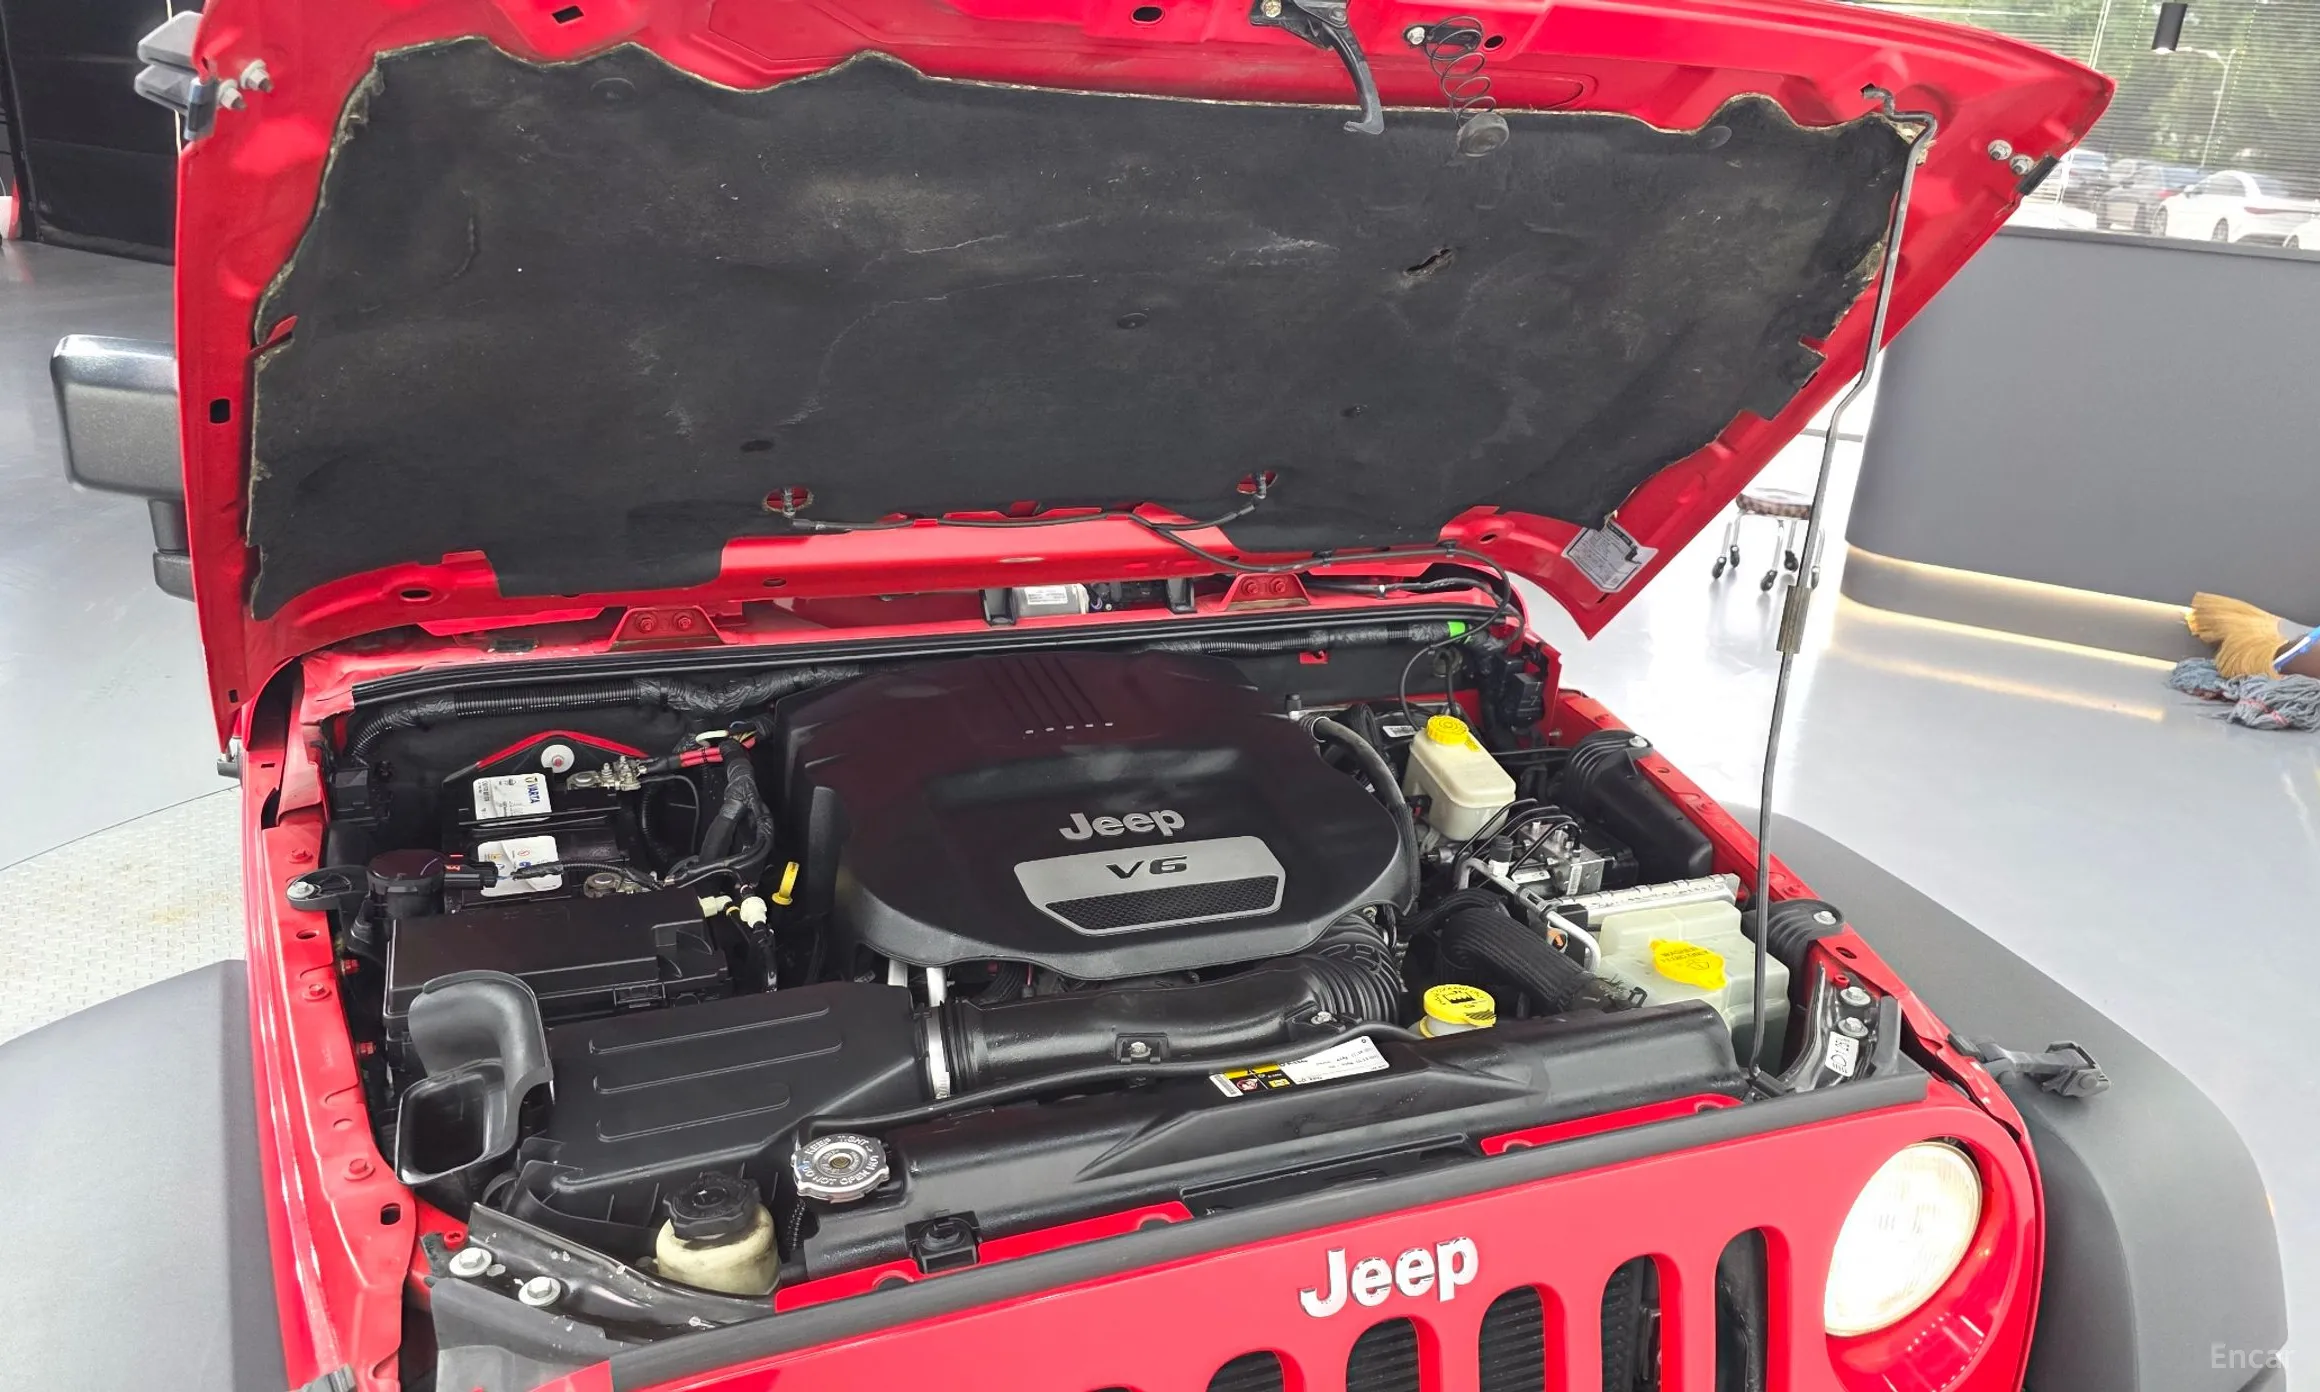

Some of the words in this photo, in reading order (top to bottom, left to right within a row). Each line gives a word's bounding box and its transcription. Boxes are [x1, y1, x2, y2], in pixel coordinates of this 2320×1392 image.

[1059, 809, 1185, 840] Jeep
[1105, 855, 1188, 879] V6
[804, 1137, 831, 1155] KEEP
[1299, 1236, 1479, 1318] Jeep
